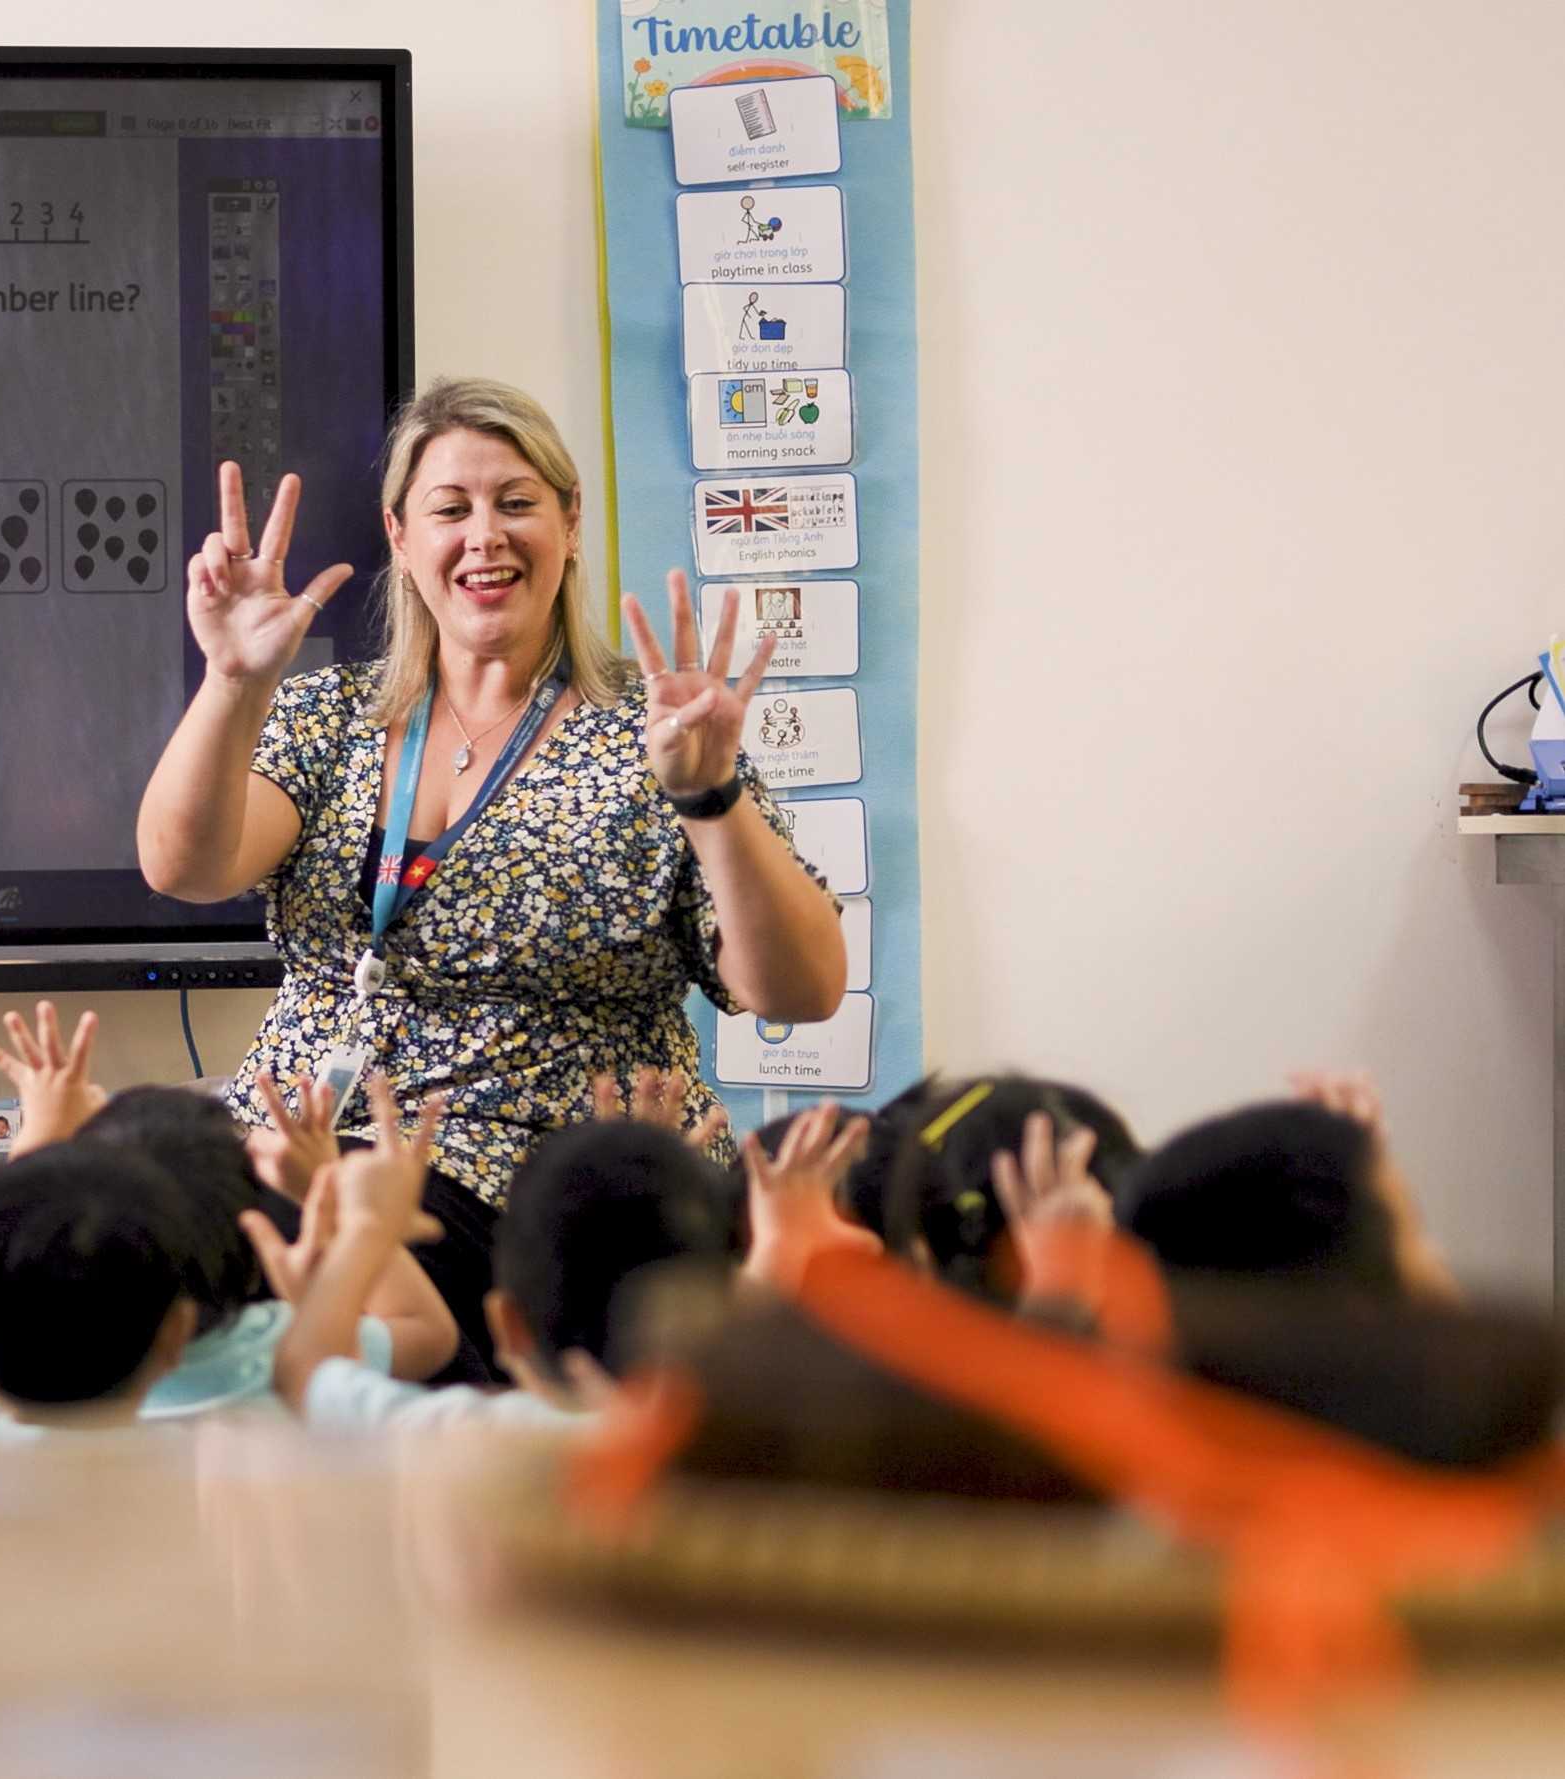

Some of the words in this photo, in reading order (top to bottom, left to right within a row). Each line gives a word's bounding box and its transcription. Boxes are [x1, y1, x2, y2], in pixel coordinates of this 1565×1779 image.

[633, 11, 861, 56] Timetable
[727, 158, 789, 172] self-register
[10, 202, 25, 225] 2
[40, 202, 54, 225] 3
[70, 202, 84, 225] 4
[711, 265, 765, 280] playtime
[768, 263, 779, 275] in
[782, 262, 813, 274] class
[69, 282, 141, 313] line?
[727, 358, 748, 371] tidy
[752, 360, 768, 370] up
[771, 357, 799, 370] time
[744, 384, 764, 393] am
[727, 446, 778, 461] morning
[781, 443, 817, 457] snack
[738, 549, 775, 563] English
[778, 547, 817, 561] phonics
[768, 656, 802, 668] eatre
[761, 767, 786, 779] ircle
[788, 766, 816, 778] time
[759, 1061, 792, 1075] lunch
[795, 1063, 822, 1077] time
